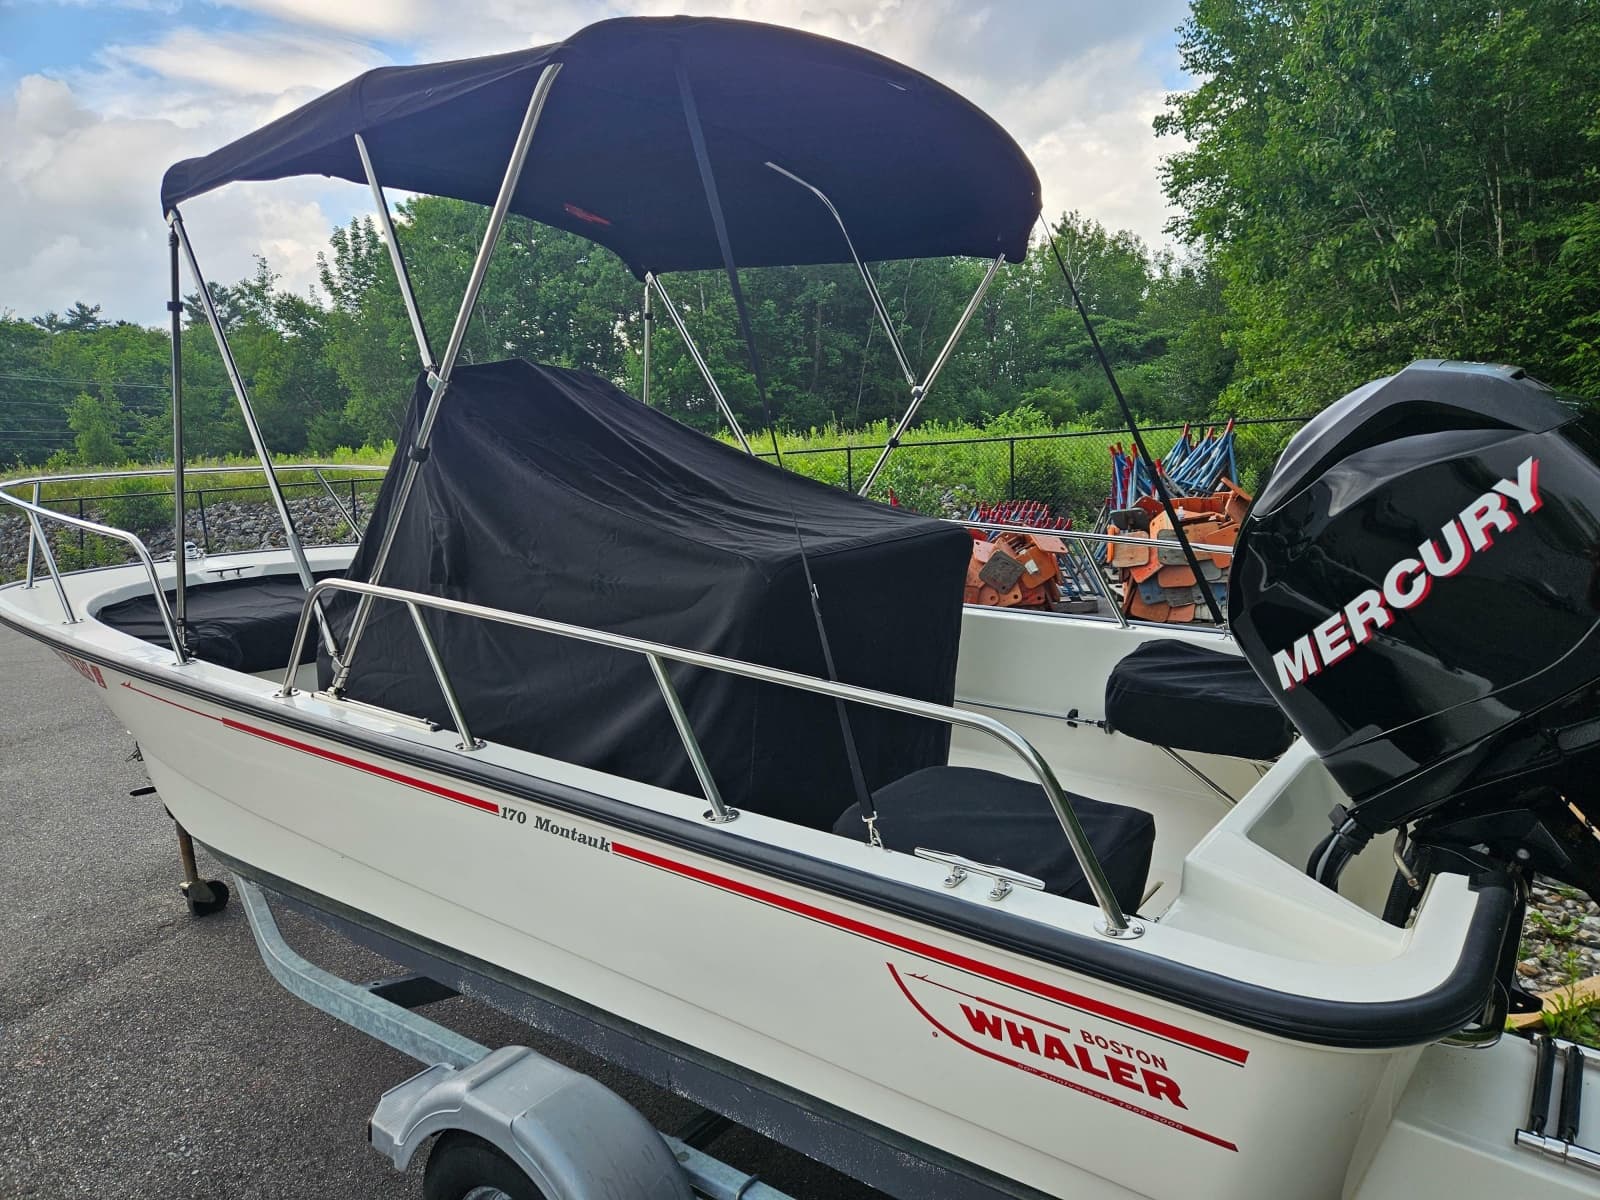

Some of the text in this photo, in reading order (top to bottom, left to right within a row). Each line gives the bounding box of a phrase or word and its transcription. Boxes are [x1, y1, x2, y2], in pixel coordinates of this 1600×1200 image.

[1272, 456, 1543, 691] MERCURY
[501, 807, 611, 852] 170 Montauk
[959, 1003, 1188, 1110] WHALER
[1080, 1029, 1167, 1071] BOSTON
